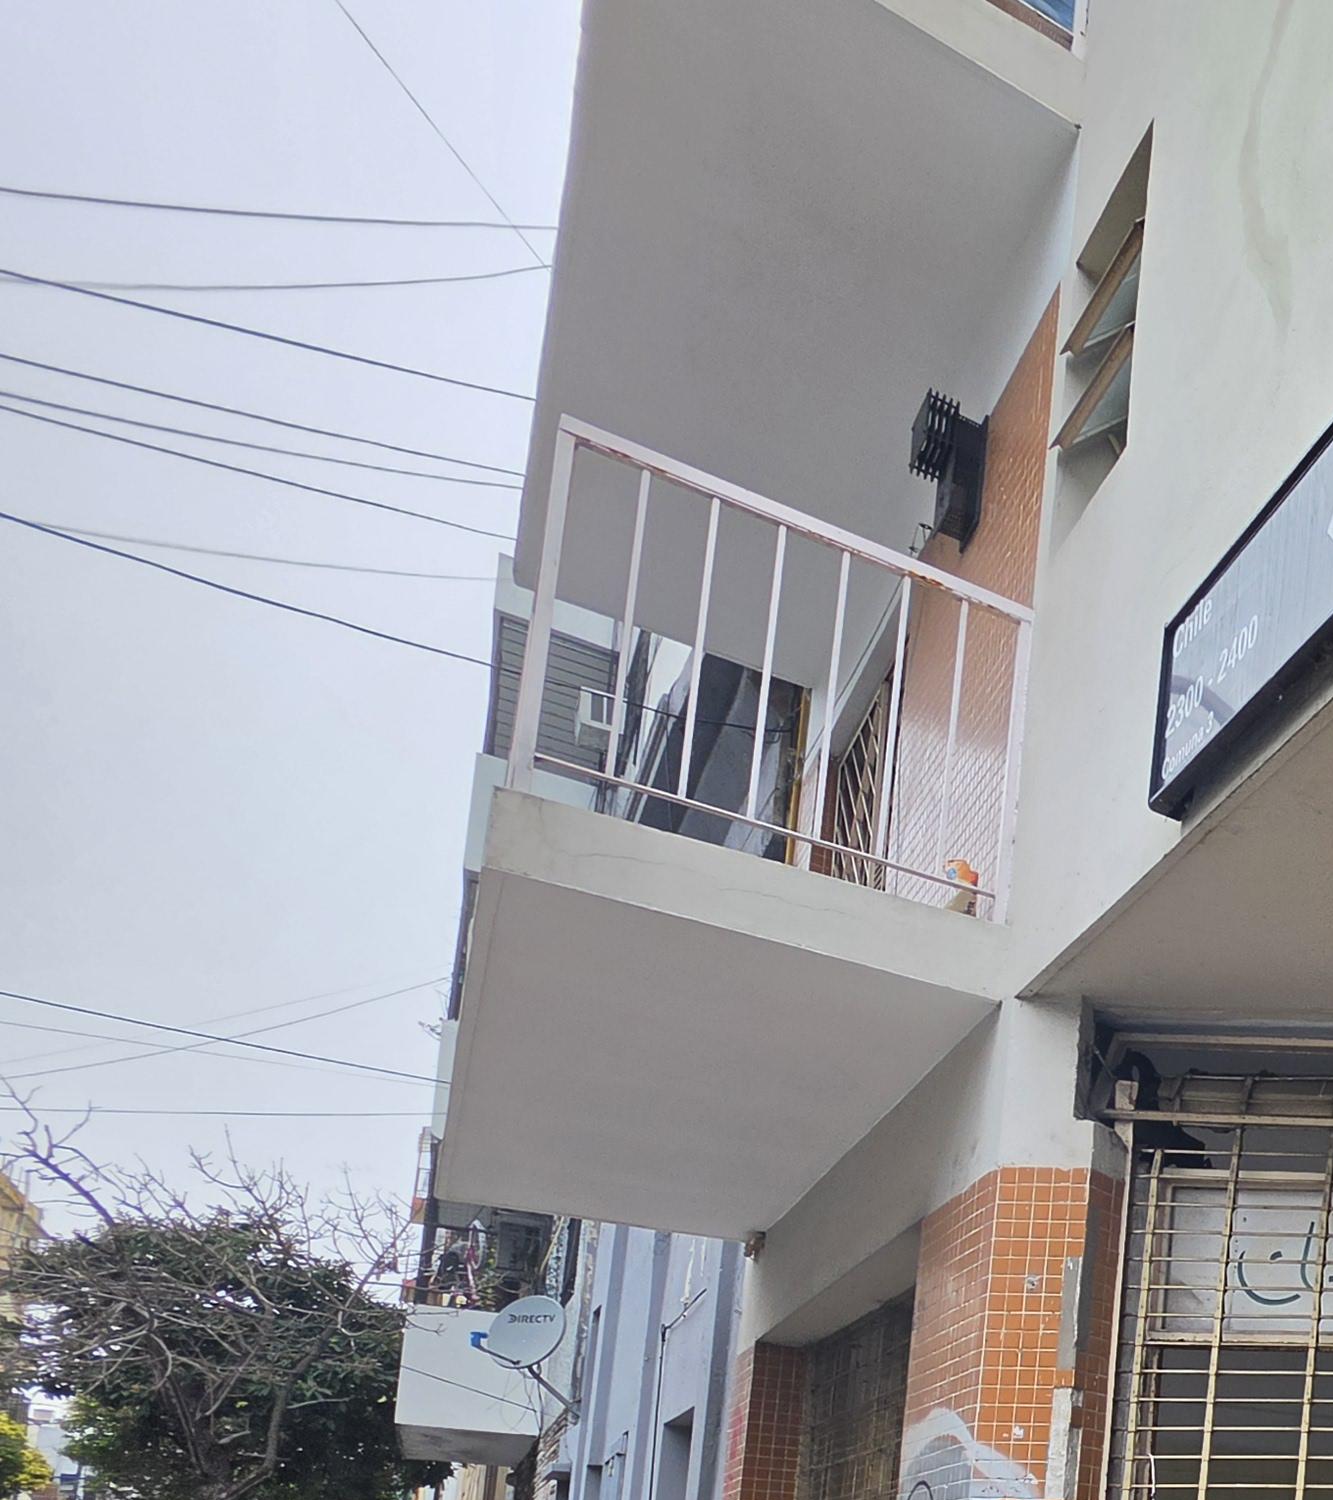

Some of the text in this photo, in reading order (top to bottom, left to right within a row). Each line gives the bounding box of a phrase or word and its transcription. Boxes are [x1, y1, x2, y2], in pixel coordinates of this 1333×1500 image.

[1173, 597, 1212, 659] Chile
[1165, 675, 1204, 738] 2300
[1217, 614, 1258, 684] 2400
[1206, 710, 1215, 734] 3
[507, 1313, 557, 1324] DIRECTV
